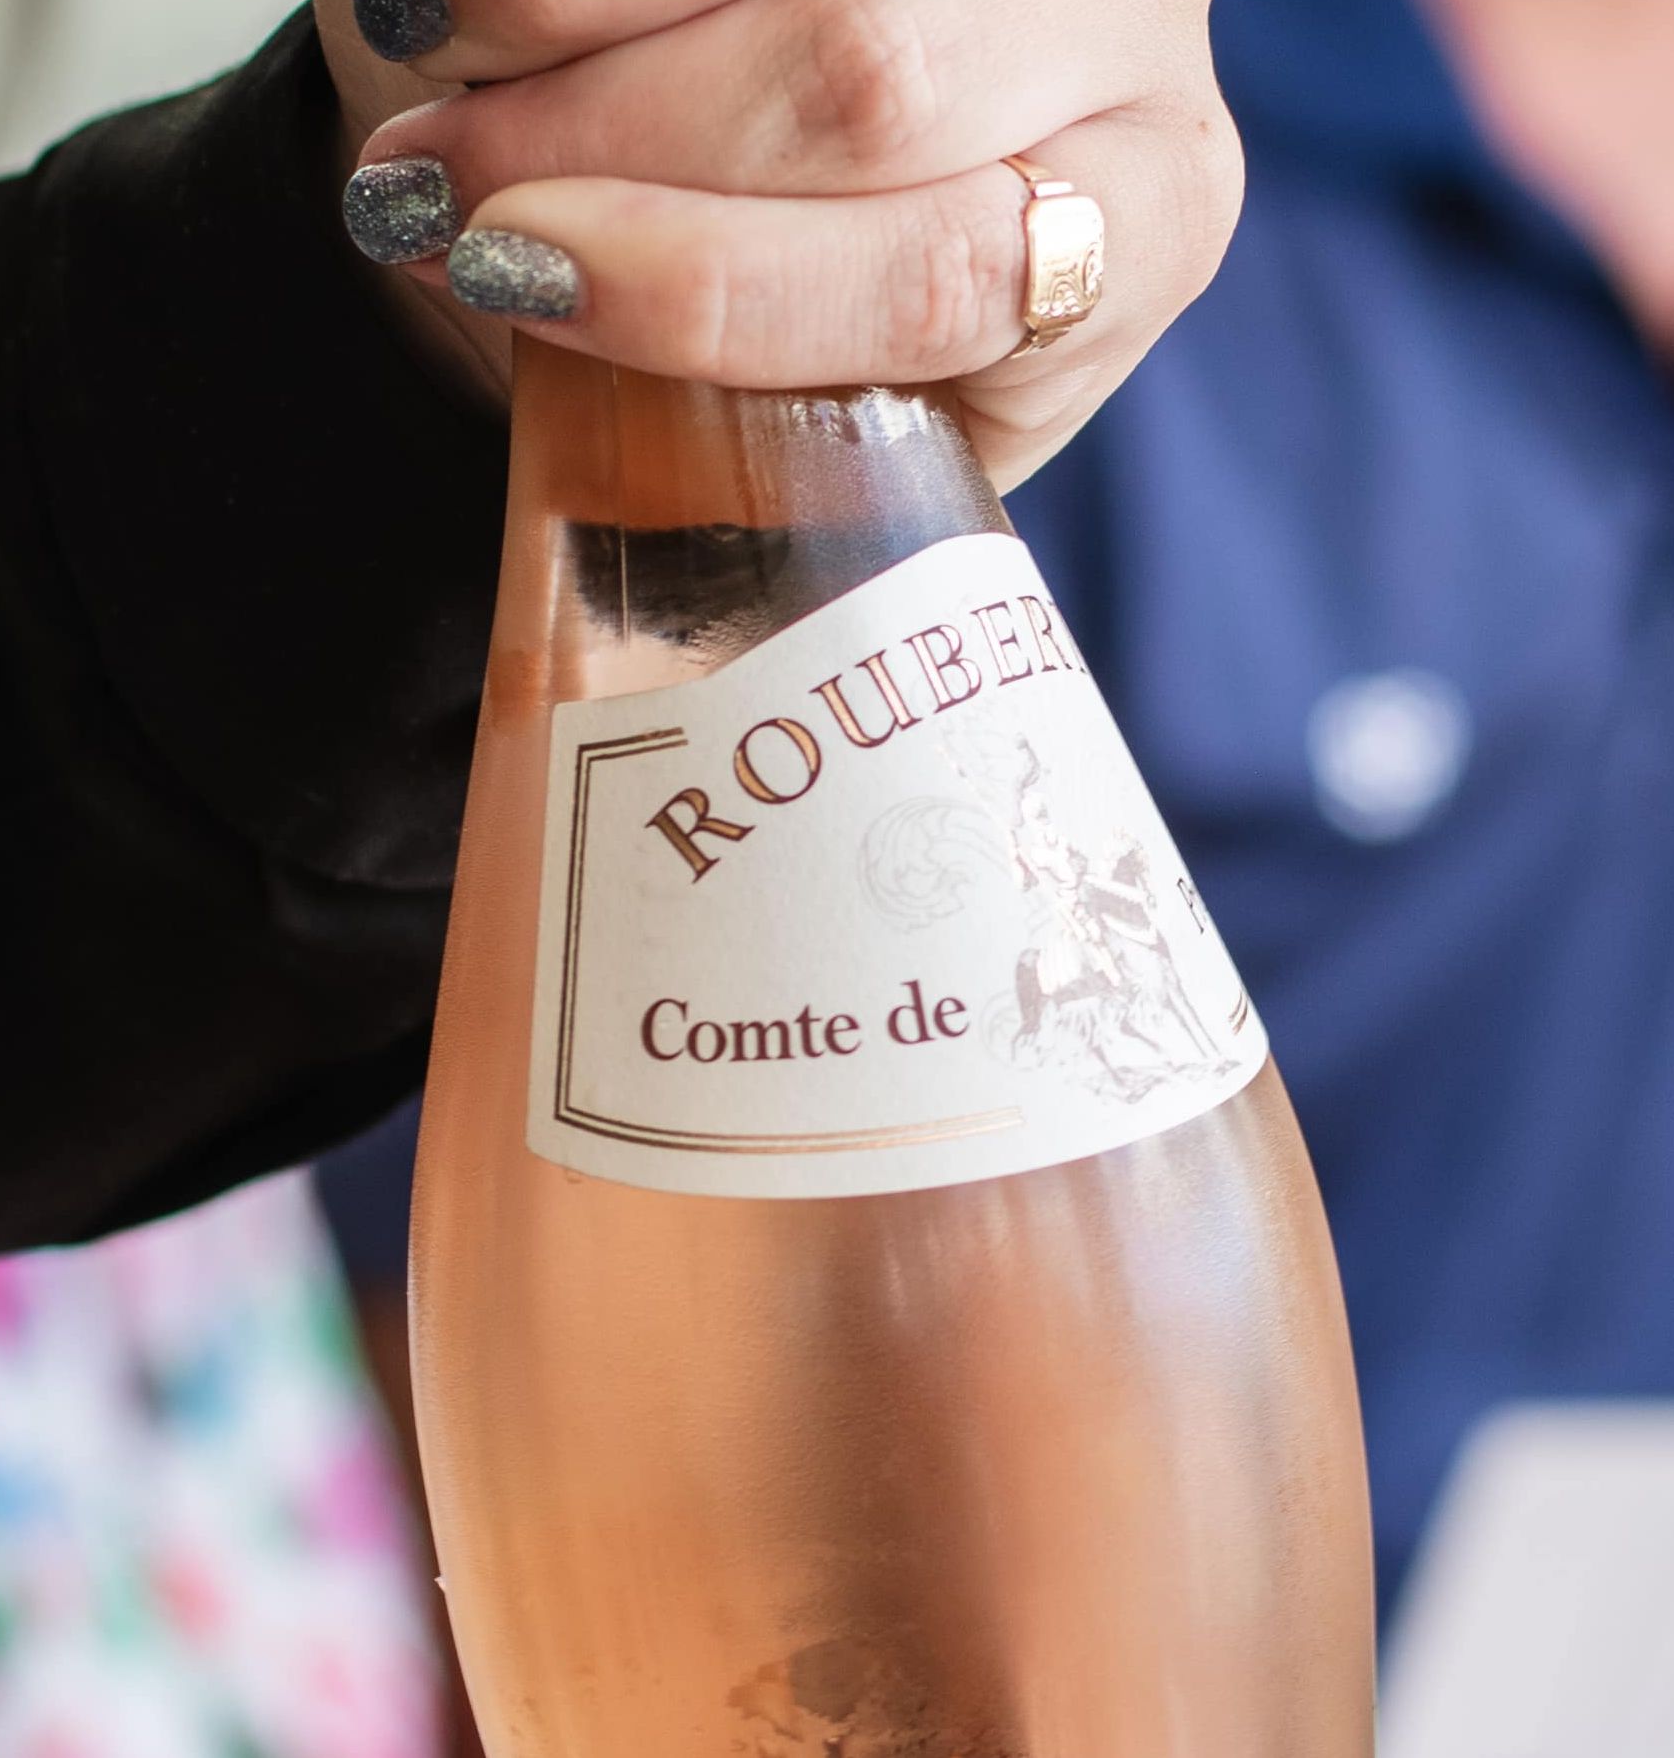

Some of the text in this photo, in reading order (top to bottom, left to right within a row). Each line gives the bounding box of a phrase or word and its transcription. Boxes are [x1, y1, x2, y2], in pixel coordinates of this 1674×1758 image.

[645, 595, 1087, 884] ROUBER
[640, 979, 970, 1063] Comte de
